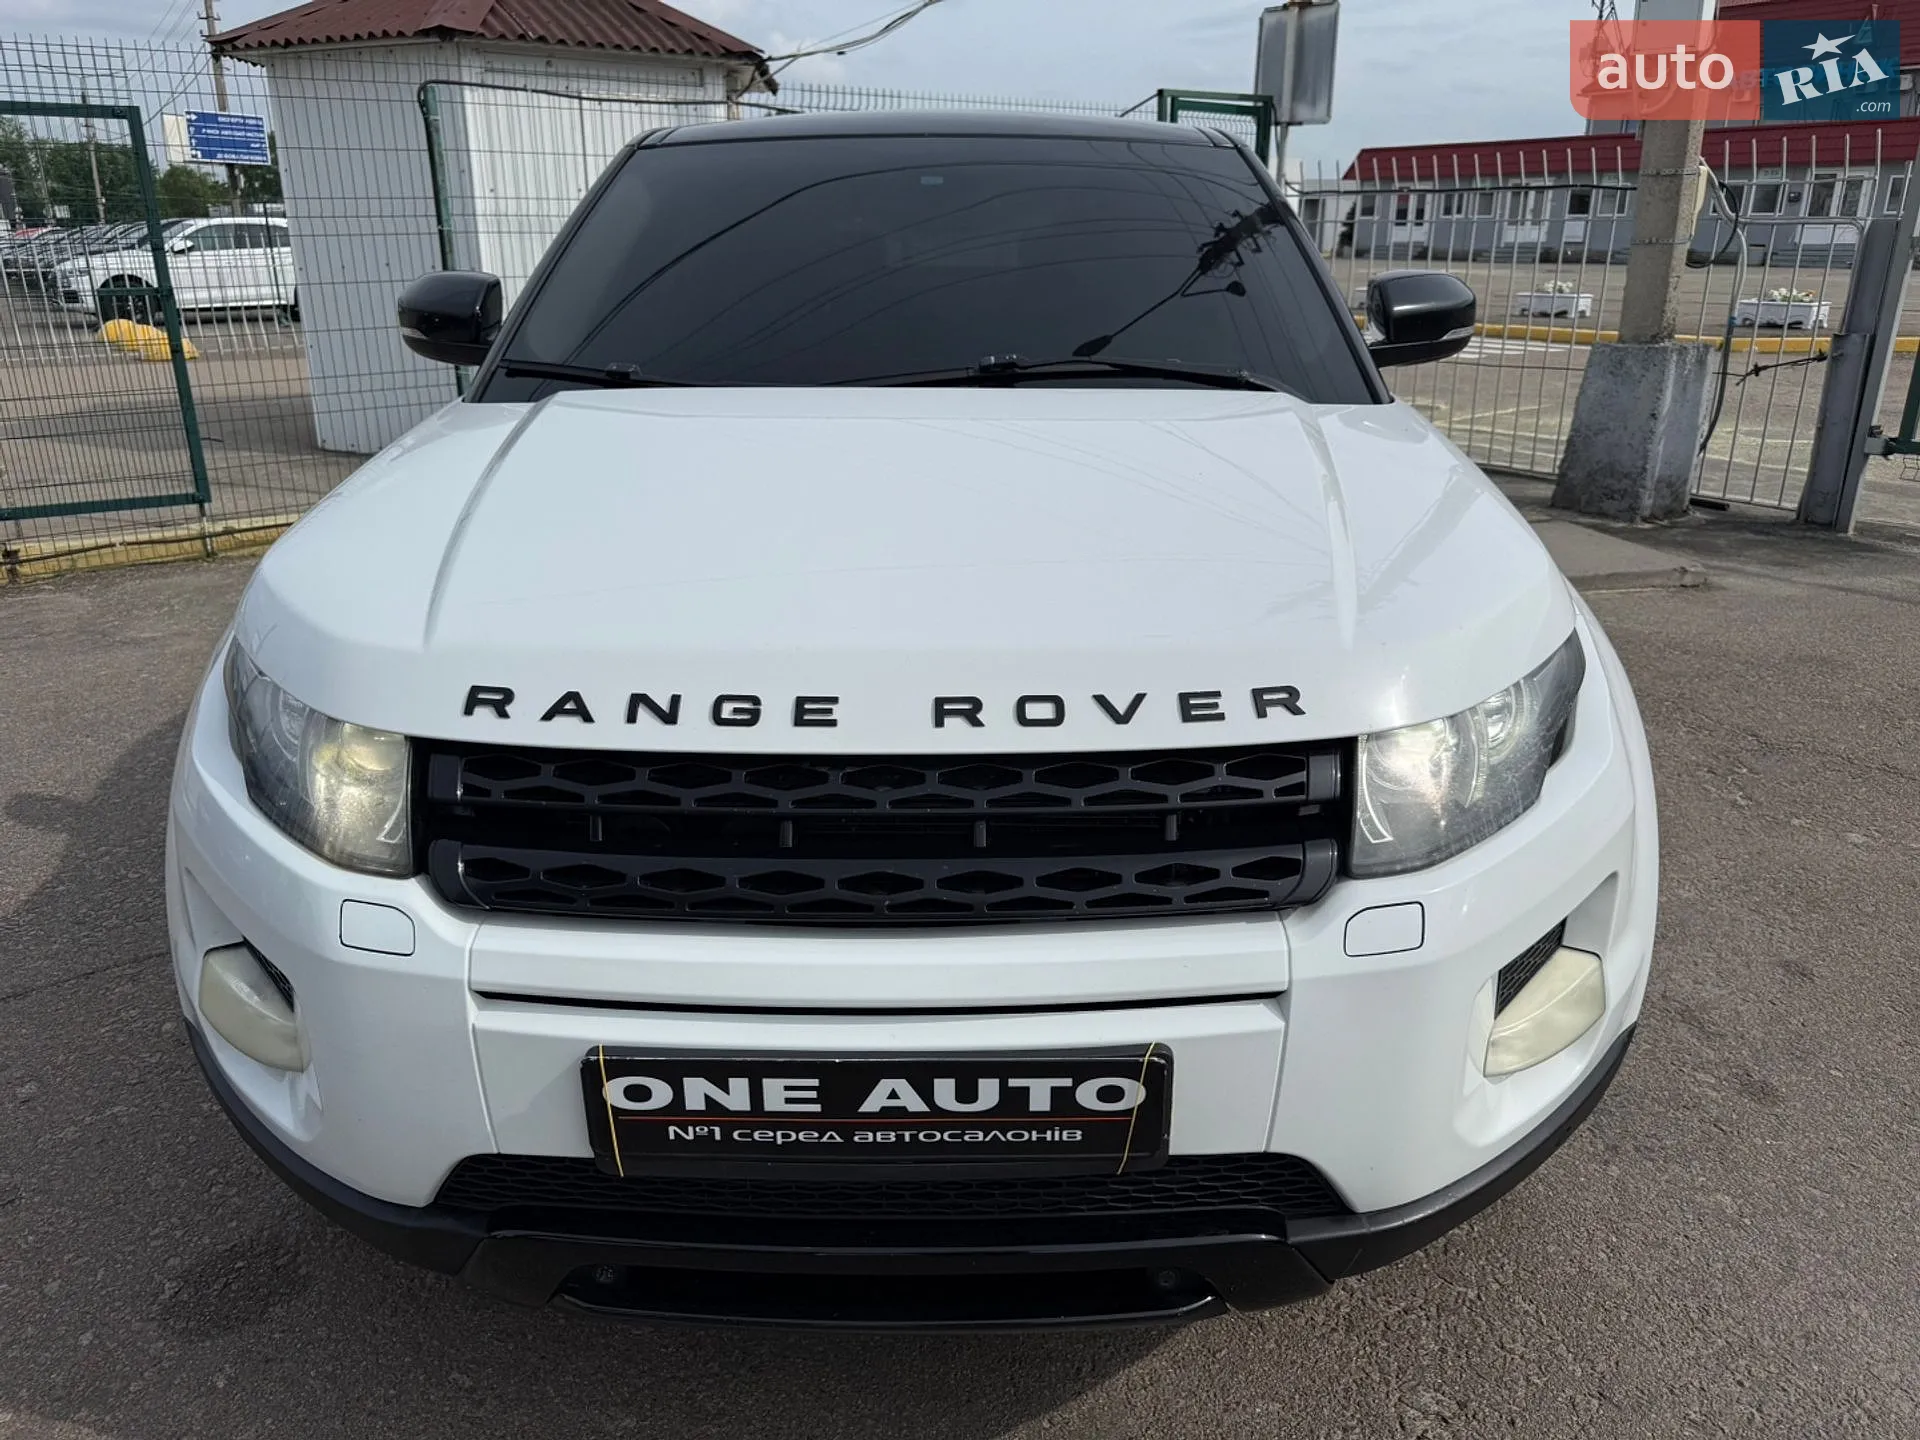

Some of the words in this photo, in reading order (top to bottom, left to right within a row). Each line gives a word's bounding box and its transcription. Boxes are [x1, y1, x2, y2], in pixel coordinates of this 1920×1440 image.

[463, 685, 840, 728] RANGE
[932, 685, 1307, 728] ROVER
[602, 1075, 822, 1112] ONE
[857, 1076, 1147, 1113] AUTO
[732, 1129, 845, 1146] серед
[853, 1126, 1084, 1144] автосалонів
